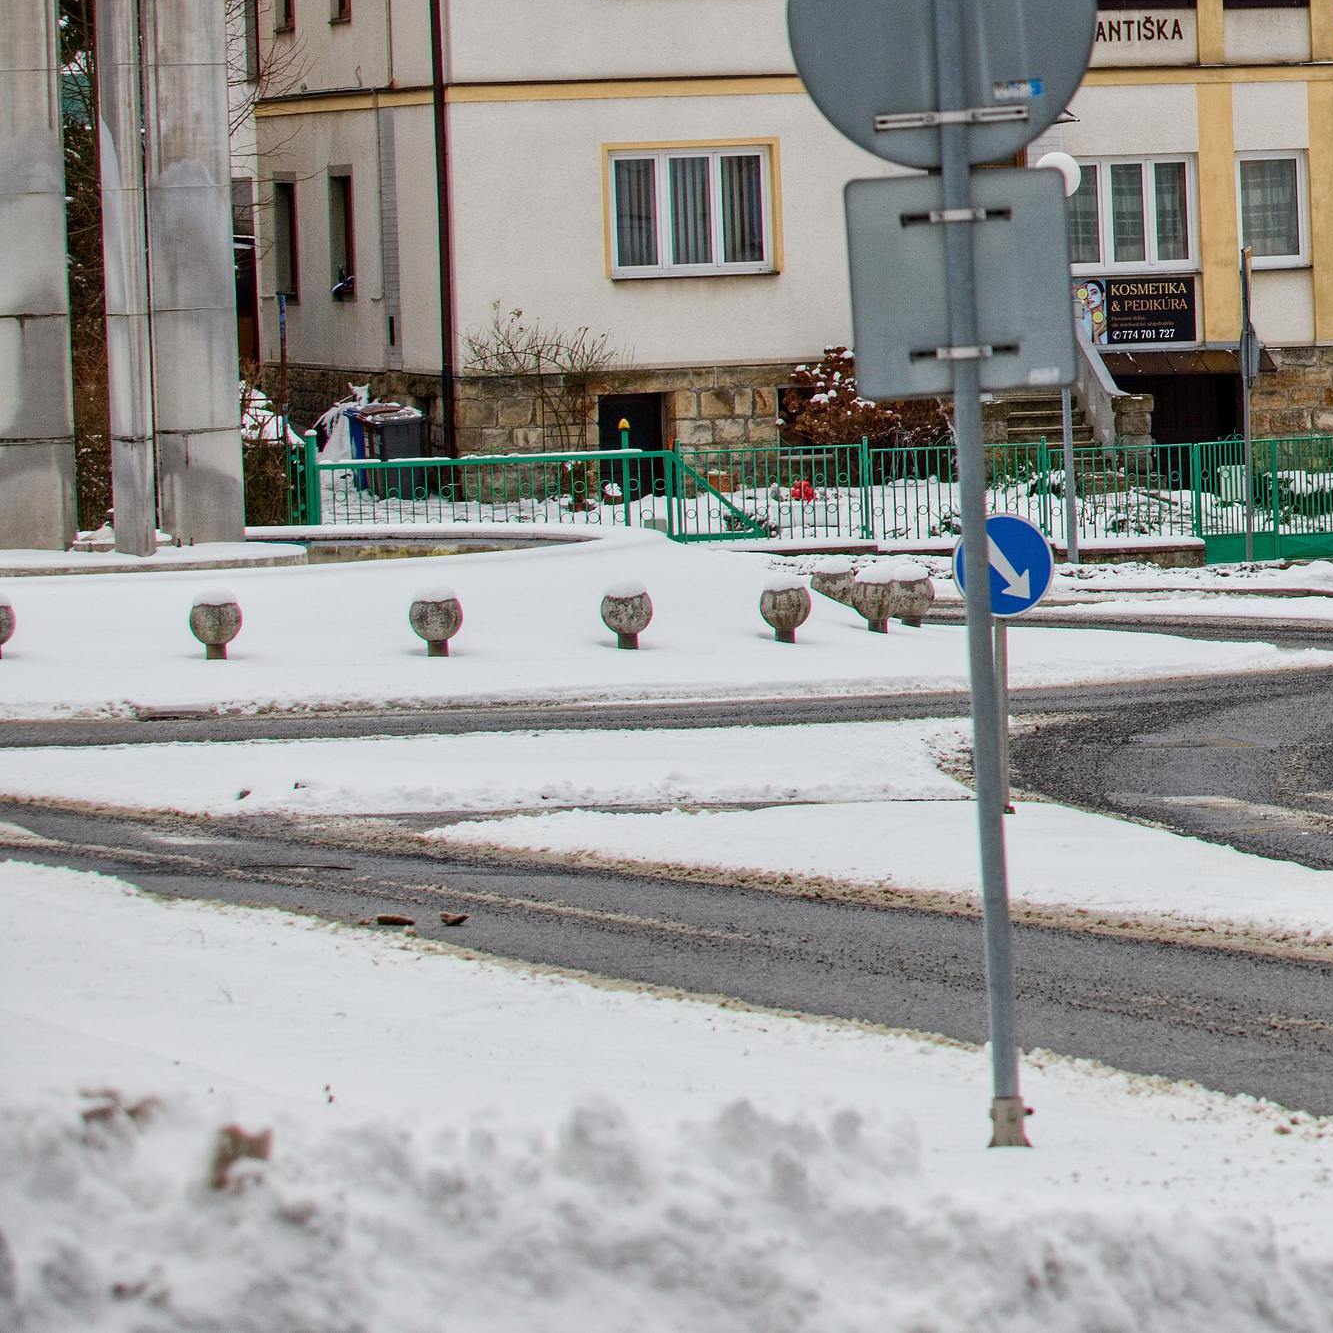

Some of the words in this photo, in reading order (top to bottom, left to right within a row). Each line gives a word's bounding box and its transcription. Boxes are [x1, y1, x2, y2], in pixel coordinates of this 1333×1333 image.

[1111, 282, 1187, 296] KOSMETIKA
[1111, 300, 1121, 312] &
[1124, 295, 1188, 312] PEDIKÚRA
[1122, 330, 1138, 340] 774
[1141, 330, 1156, 339] 701
[1159, 329, 1175, 338] 727
